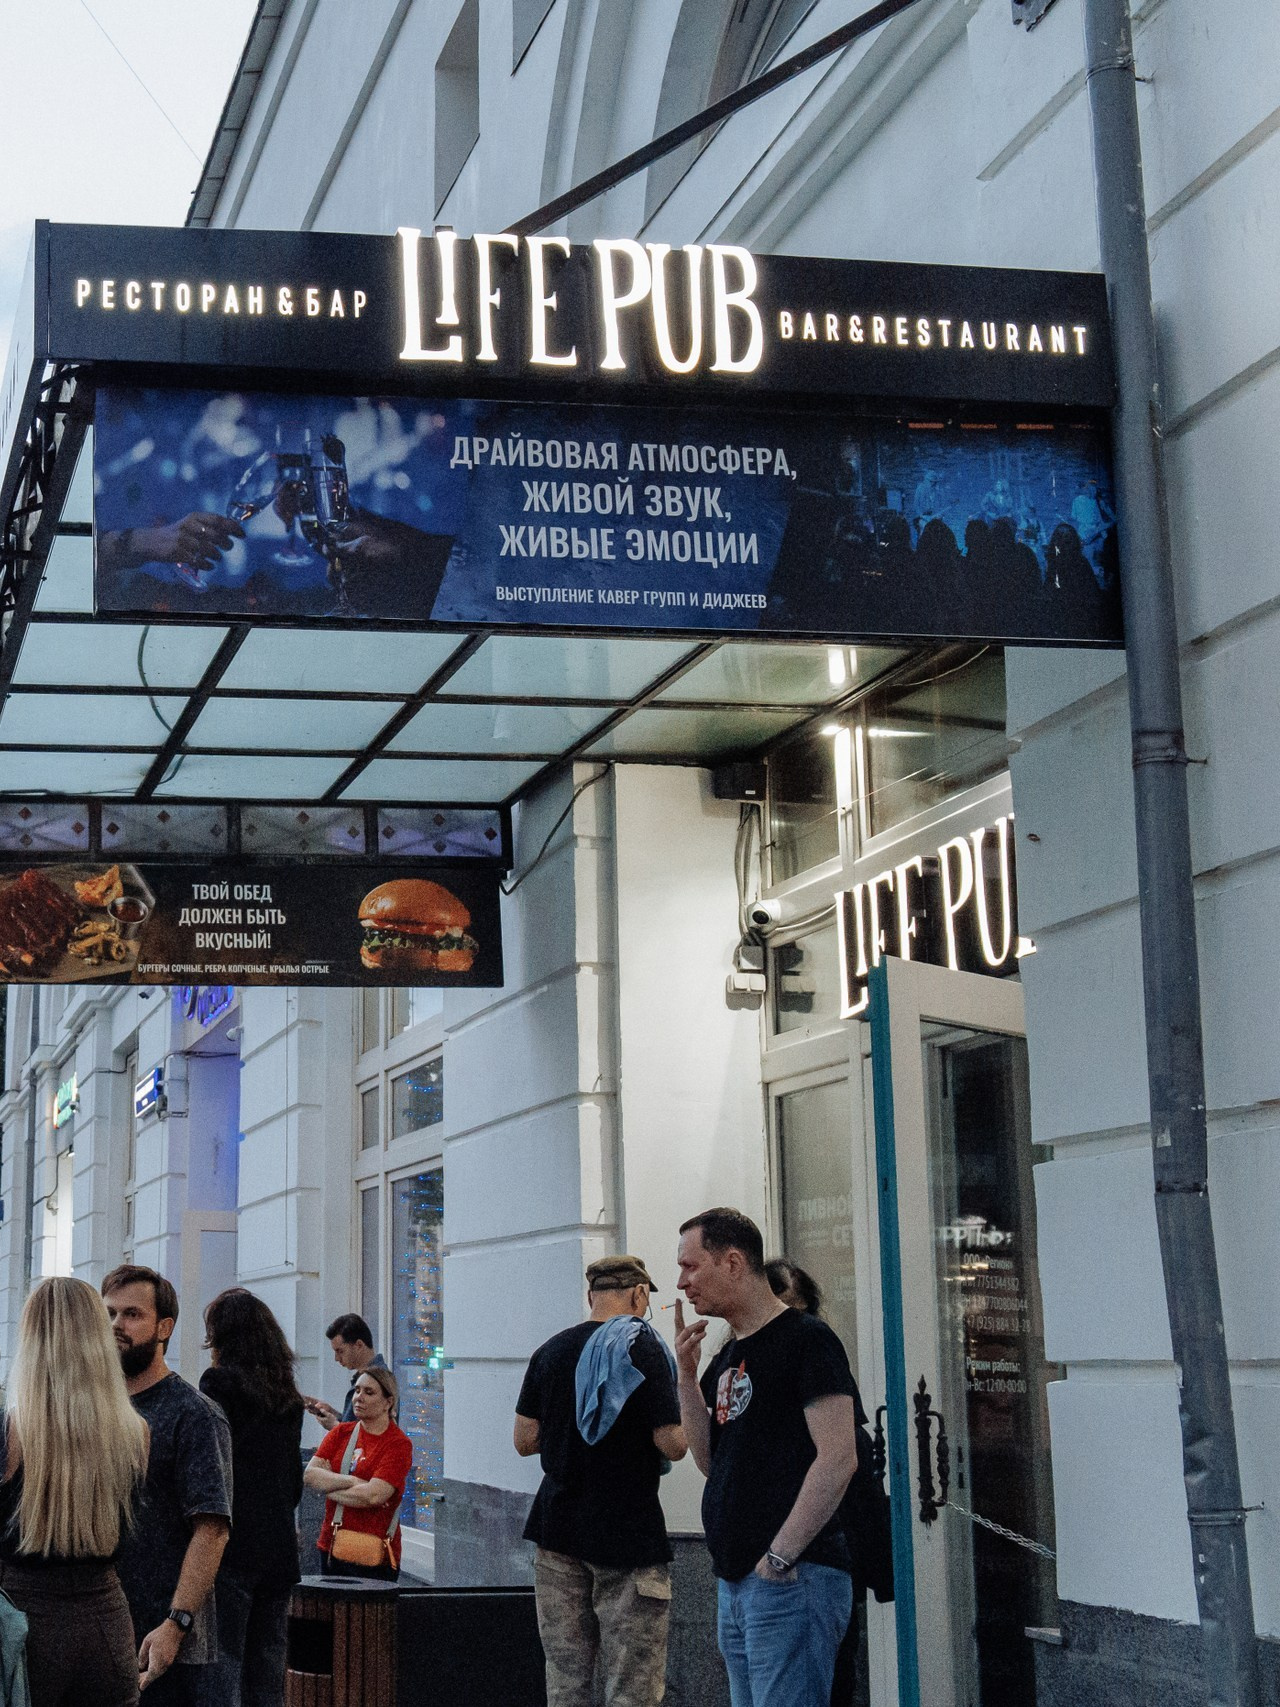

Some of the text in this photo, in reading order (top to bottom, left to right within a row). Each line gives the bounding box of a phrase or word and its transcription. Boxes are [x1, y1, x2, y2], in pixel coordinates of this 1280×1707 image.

[395, 226, 764, 374] LIFE PUB
[450, 432, 798, 480] ДРАЙВОВАЯ АТМОСФЕРА,
[522, 477, 732, 522] ЖИВОЙ ЗВУК,
[498, 524, 760, 569] ЖИВЫЕ ЭМОЦИИ
[495, 586, 768, 609] ВЫСТУПЛЕНИЕ КАВЕР ГРУПП И ДИДЖЕЕВ
[191, 880, 273, 903] ТВОЙ ОБЕД
[937, 813, 1037, 972] PU
[178, 908, 287, 927] ДОЛЖЕН БЫТЬ
[195, 929, 272, 950] ВКУСНЫЙ!
[137, 963, 330, 974] БУРГЕРЫ СОЧНЫЕ, РЕБРА КОПЧЕНЫЕ, КРЫЛЬЯ ОСТРЫЕ
